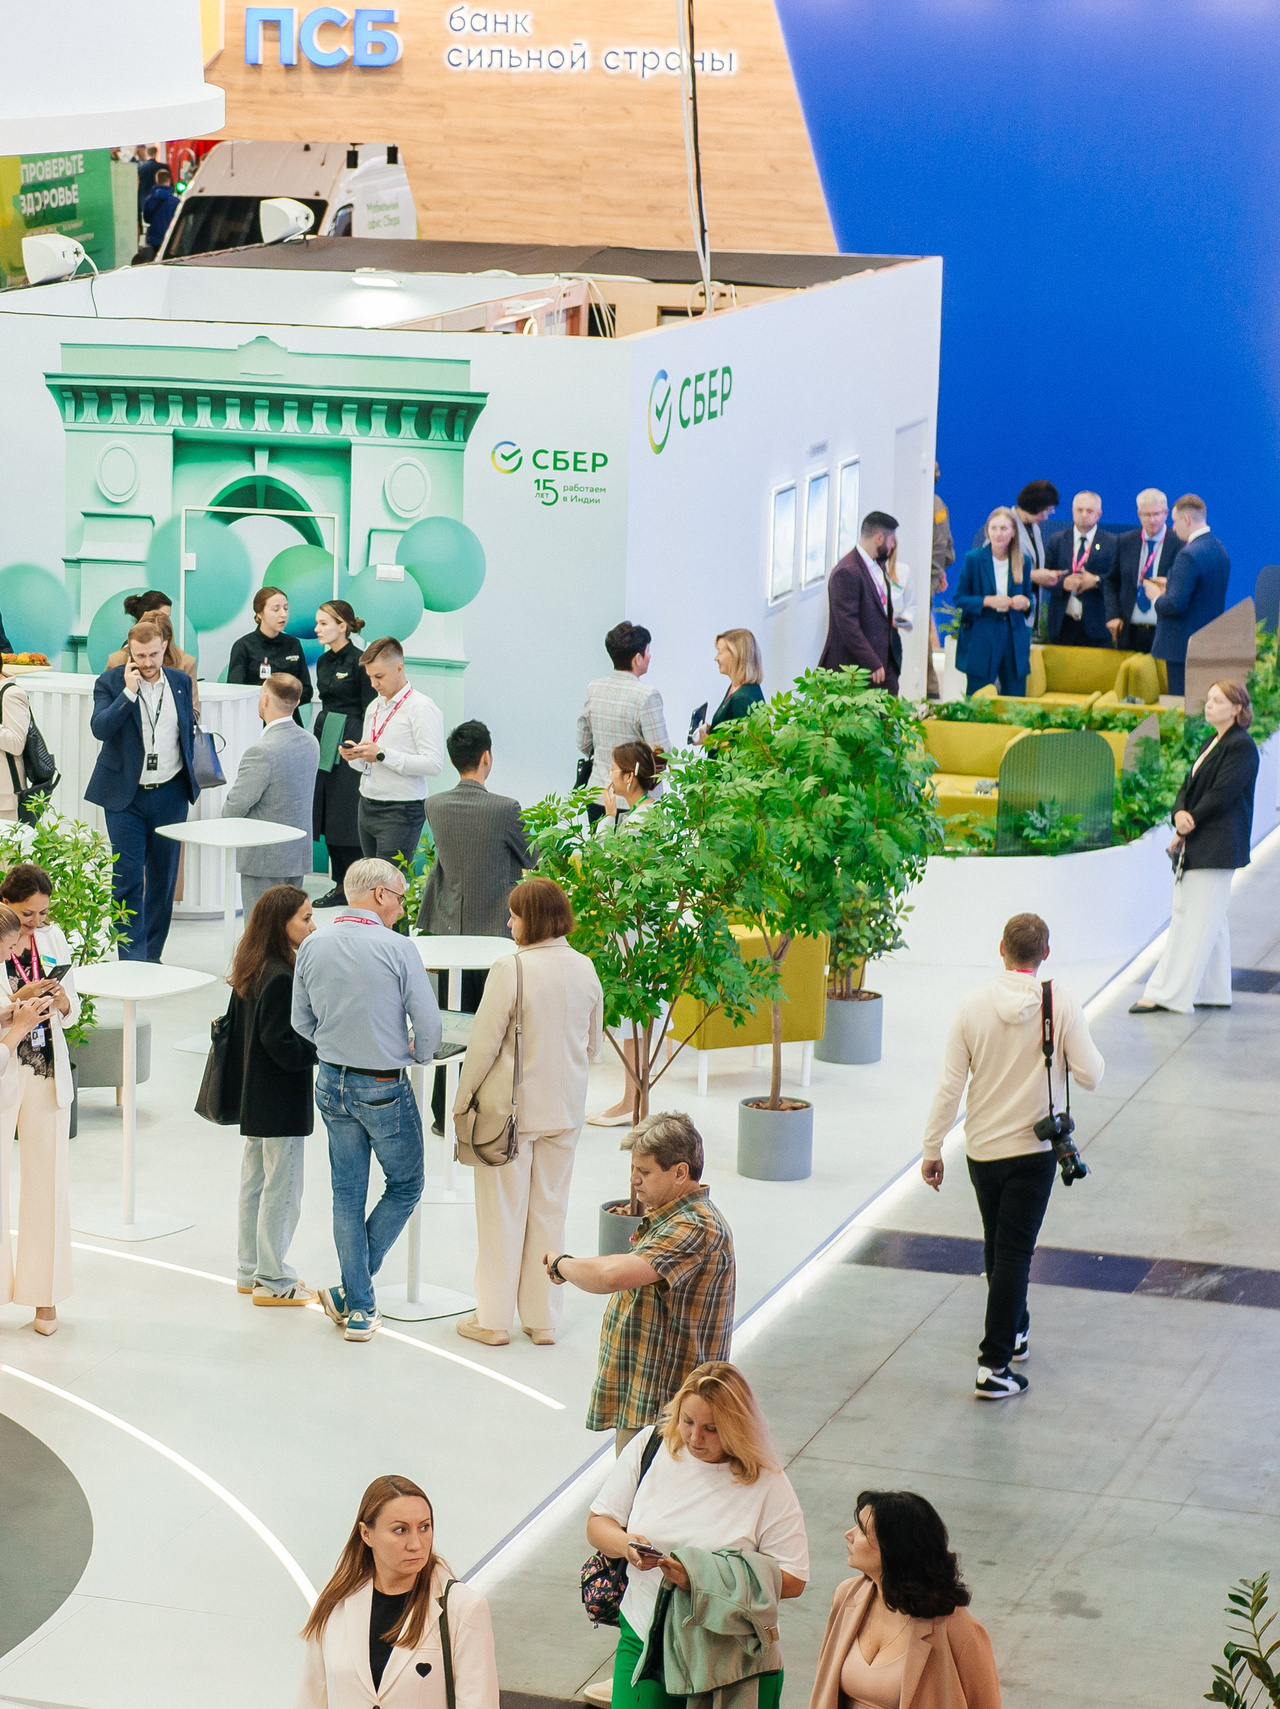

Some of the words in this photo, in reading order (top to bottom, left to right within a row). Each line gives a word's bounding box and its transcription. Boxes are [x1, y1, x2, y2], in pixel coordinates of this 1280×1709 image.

[448, 5, 531, 34] банк
[245, 7, 402, 67] ПСБ
[447, 42, 587, 70] сильной
[604, 50, 734, 79] страны
[21, 154, 84, 183] ПРОВЕРЬТЕ
[20, 184, 79, 216] ЗДОРОВЬЕ
[679, 365, 732, 429] СБЕР
[532, 449, 609, 473] СБЕР
[534, 478, 559, 507] 15
[563, 483, 607, 494] работаем
[570, 494, 601, 505] Индии
